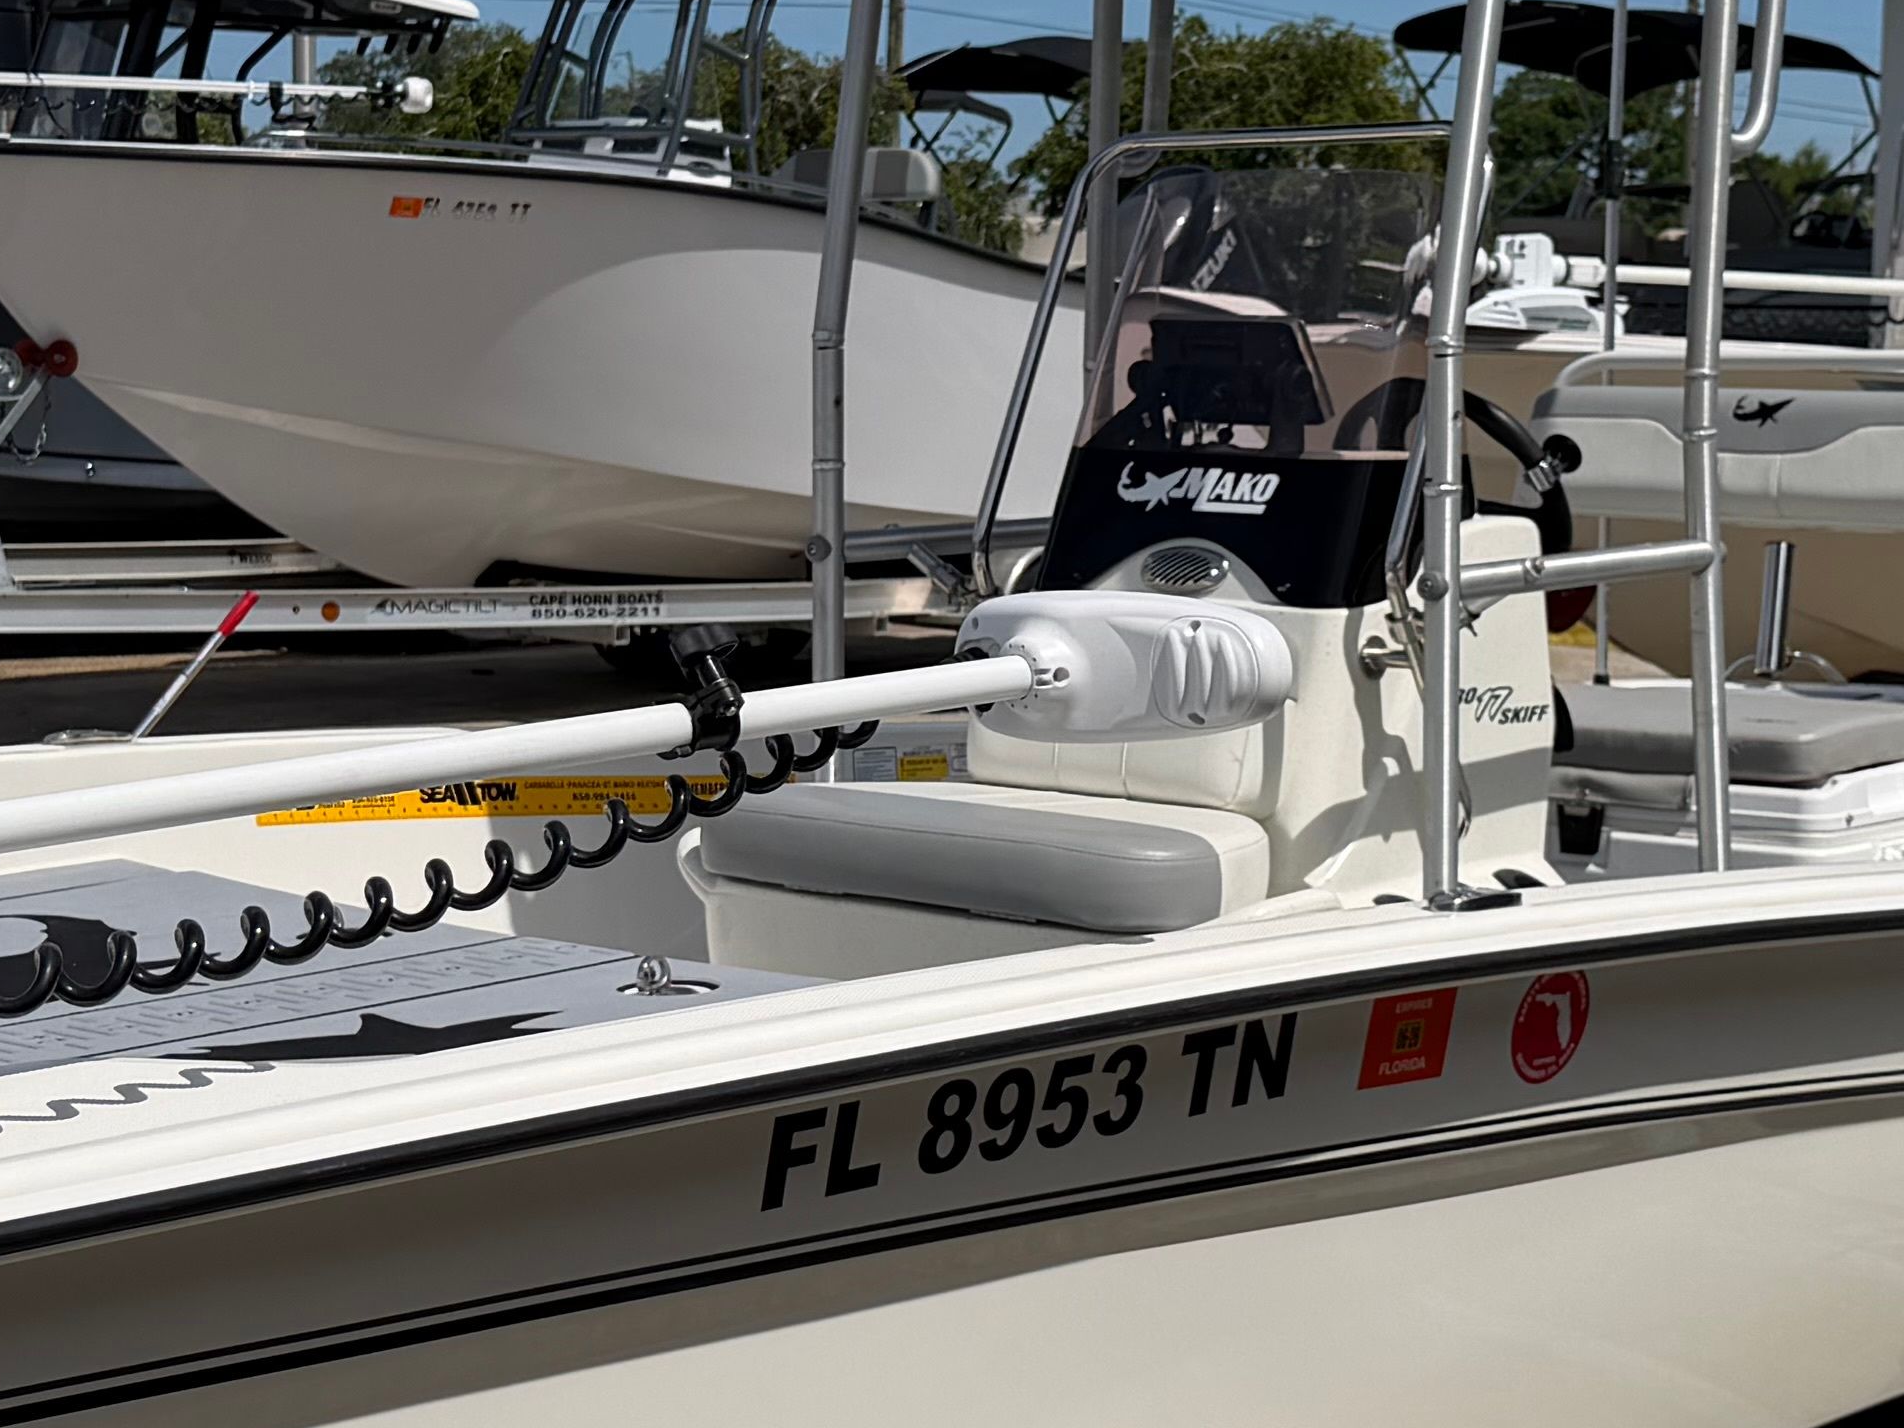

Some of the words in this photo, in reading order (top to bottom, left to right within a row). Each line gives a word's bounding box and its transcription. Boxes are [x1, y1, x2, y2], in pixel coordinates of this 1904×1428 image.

[1191, 228, 1237, 291] ZUKI
[1168, 467, 1281, 515] MAKO
[529, 594, 567, 606] CAPE
[572, 593, 612, 606] HORN
[617, 591, 664, 605] BOATS
[531, 606, 661, 619] 850-626-2211
[1498, 704, 1550, 725] SKIFF
[419, 783, 454, 804] SEA
[478, 782, 516, 802] TOW
[1378, 1055, 1427, 1076] FLORIDA
[761, 1100, 881, 1212] FL
[917, 1044, 1148, 1174] 8953
[1181, 1011, 1298, 1117] TN
